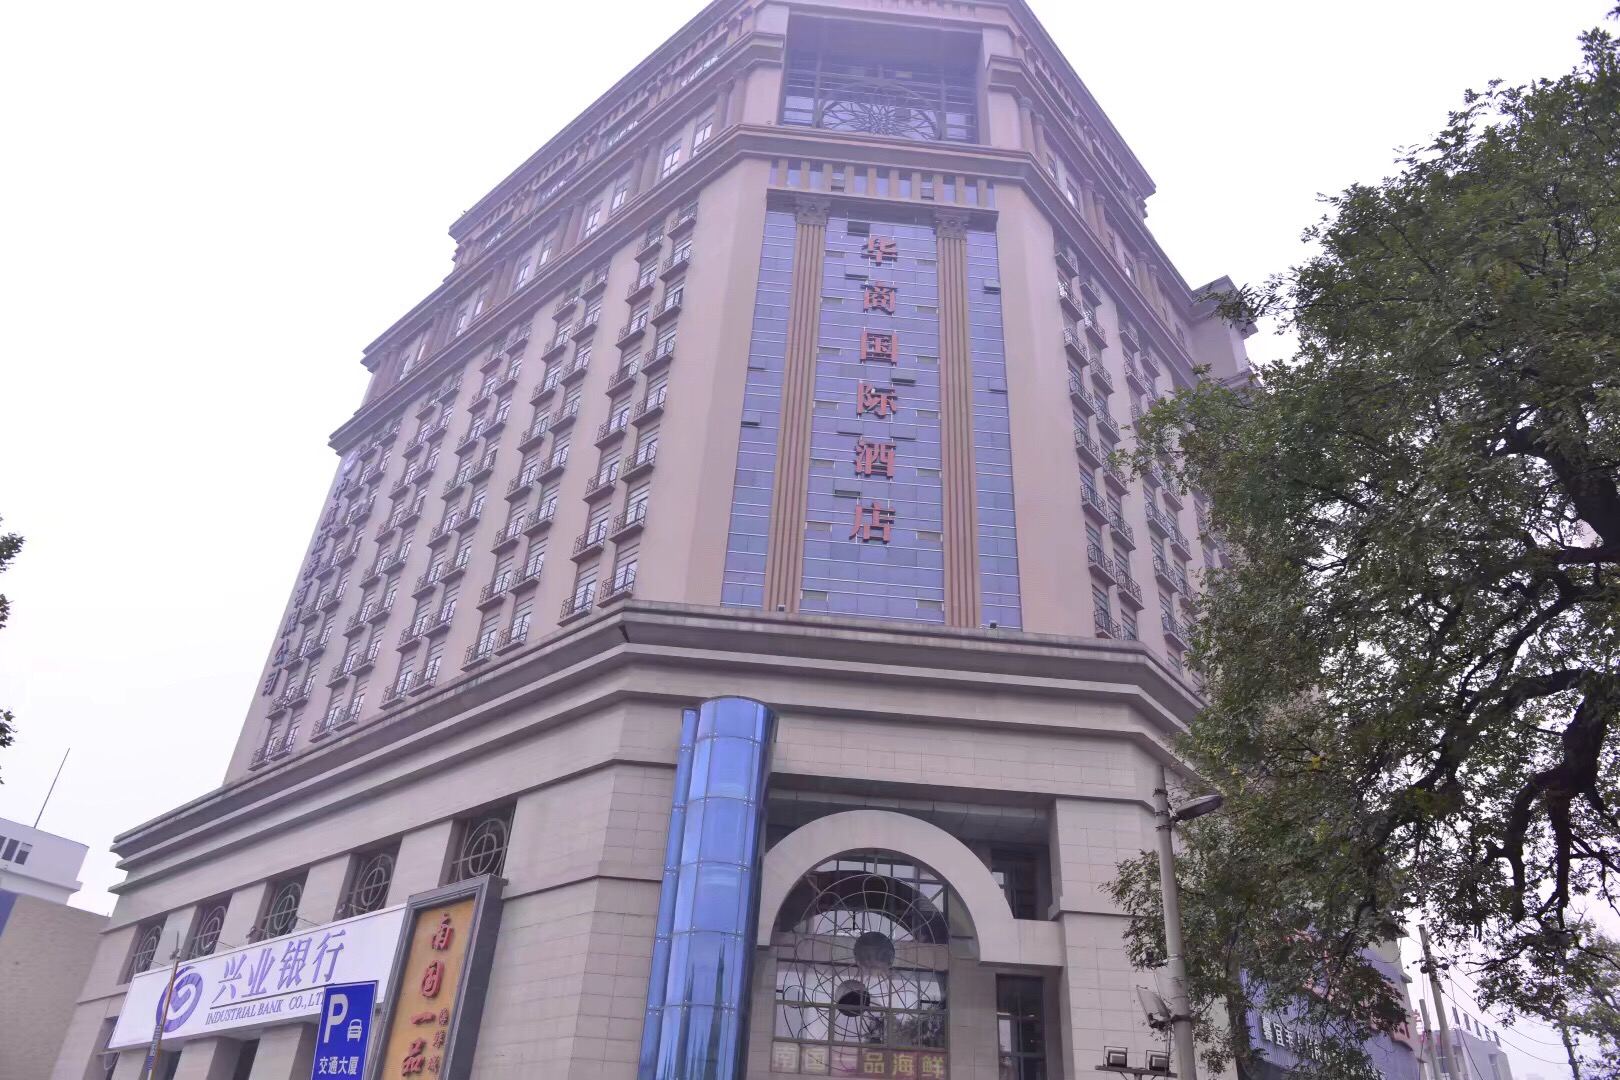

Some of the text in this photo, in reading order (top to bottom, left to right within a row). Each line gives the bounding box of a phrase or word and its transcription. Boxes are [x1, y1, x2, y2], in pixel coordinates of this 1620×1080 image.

[849, 236, 899, 544] 华商国际酒店
[212, 929, 347, 1004] 兴业银行
[205, 1004, 256, 1025] INDUSTRIAL
[257, 999, 284, 1016] BANK
[323, 993, 349, 1044] P
[318, 1056, 360, 1075] 交通大厦
[774, 1046, 945, 1079] 南国一品海鲜
